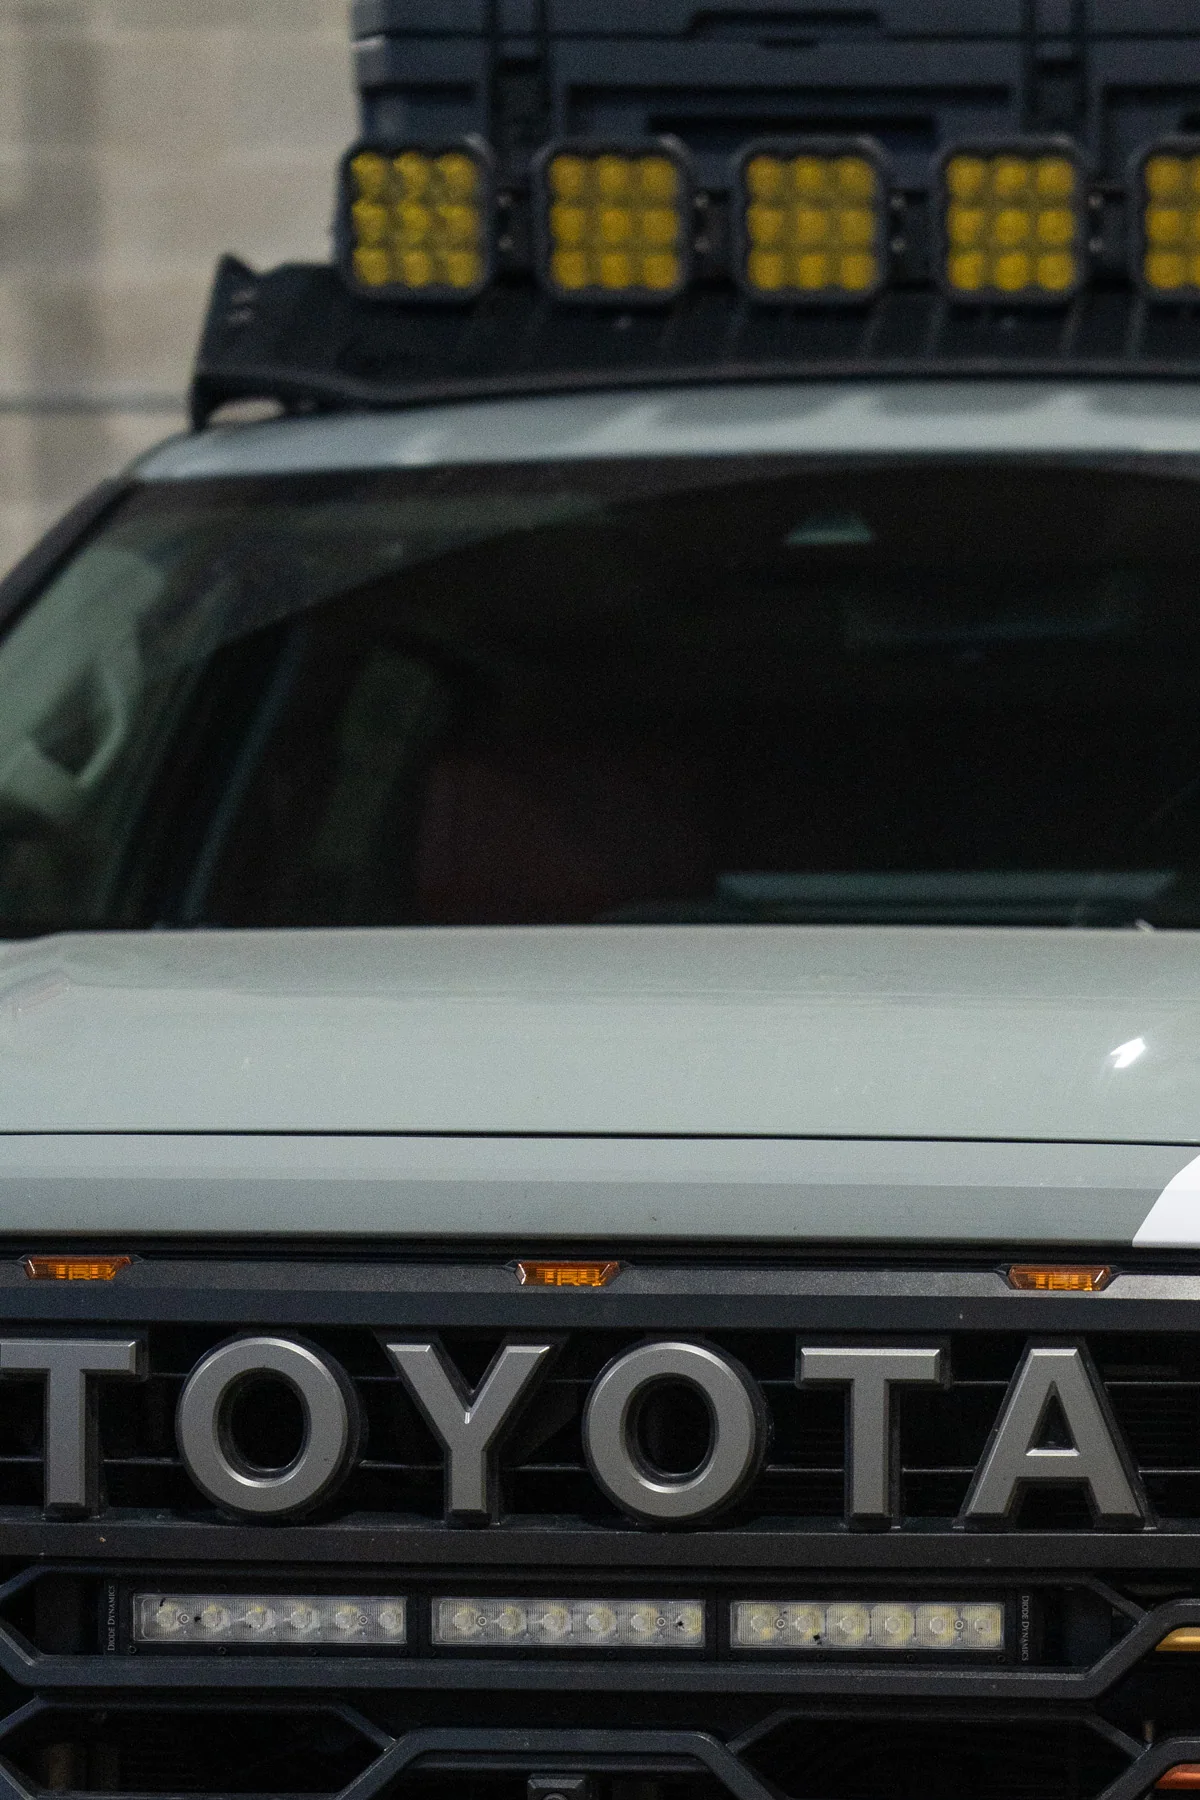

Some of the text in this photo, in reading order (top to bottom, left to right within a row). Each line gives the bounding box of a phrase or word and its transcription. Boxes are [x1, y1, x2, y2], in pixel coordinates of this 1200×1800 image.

[0, 1338, 1146, 1524] TOYOTA
[107, 1585, 115, 1652] DIODE DYNAMICS
[1021, 1595, 1029, 1662] DIODE DYNAMICS
